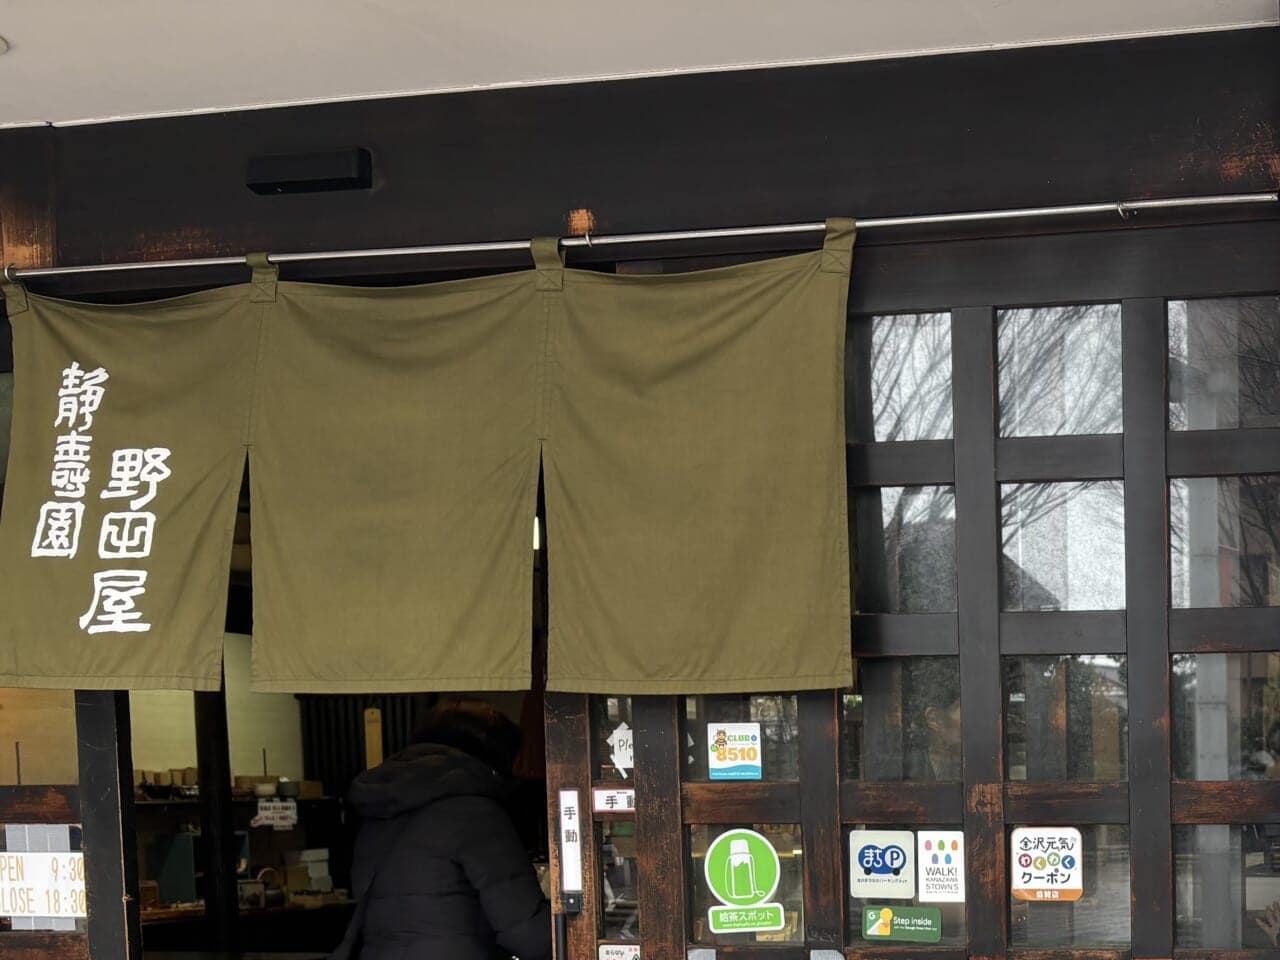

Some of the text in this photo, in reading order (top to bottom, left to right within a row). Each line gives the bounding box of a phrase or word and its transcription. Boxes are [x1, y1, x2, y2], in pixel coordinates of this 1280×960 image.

[78, 446, 172, 635] 野田屋
[563, 805, 578, 843] 手動
[1019, 836, 1075, 853] 金沢元気
[52, 856, 84, 882] 9:30
[925, 867, 958, 877] WALK!
[1021, 868, 1071, 885] クーポン
[0, 887, 87, 914] LOSE 18:30
[893, 916, 932, 926] Step inside
